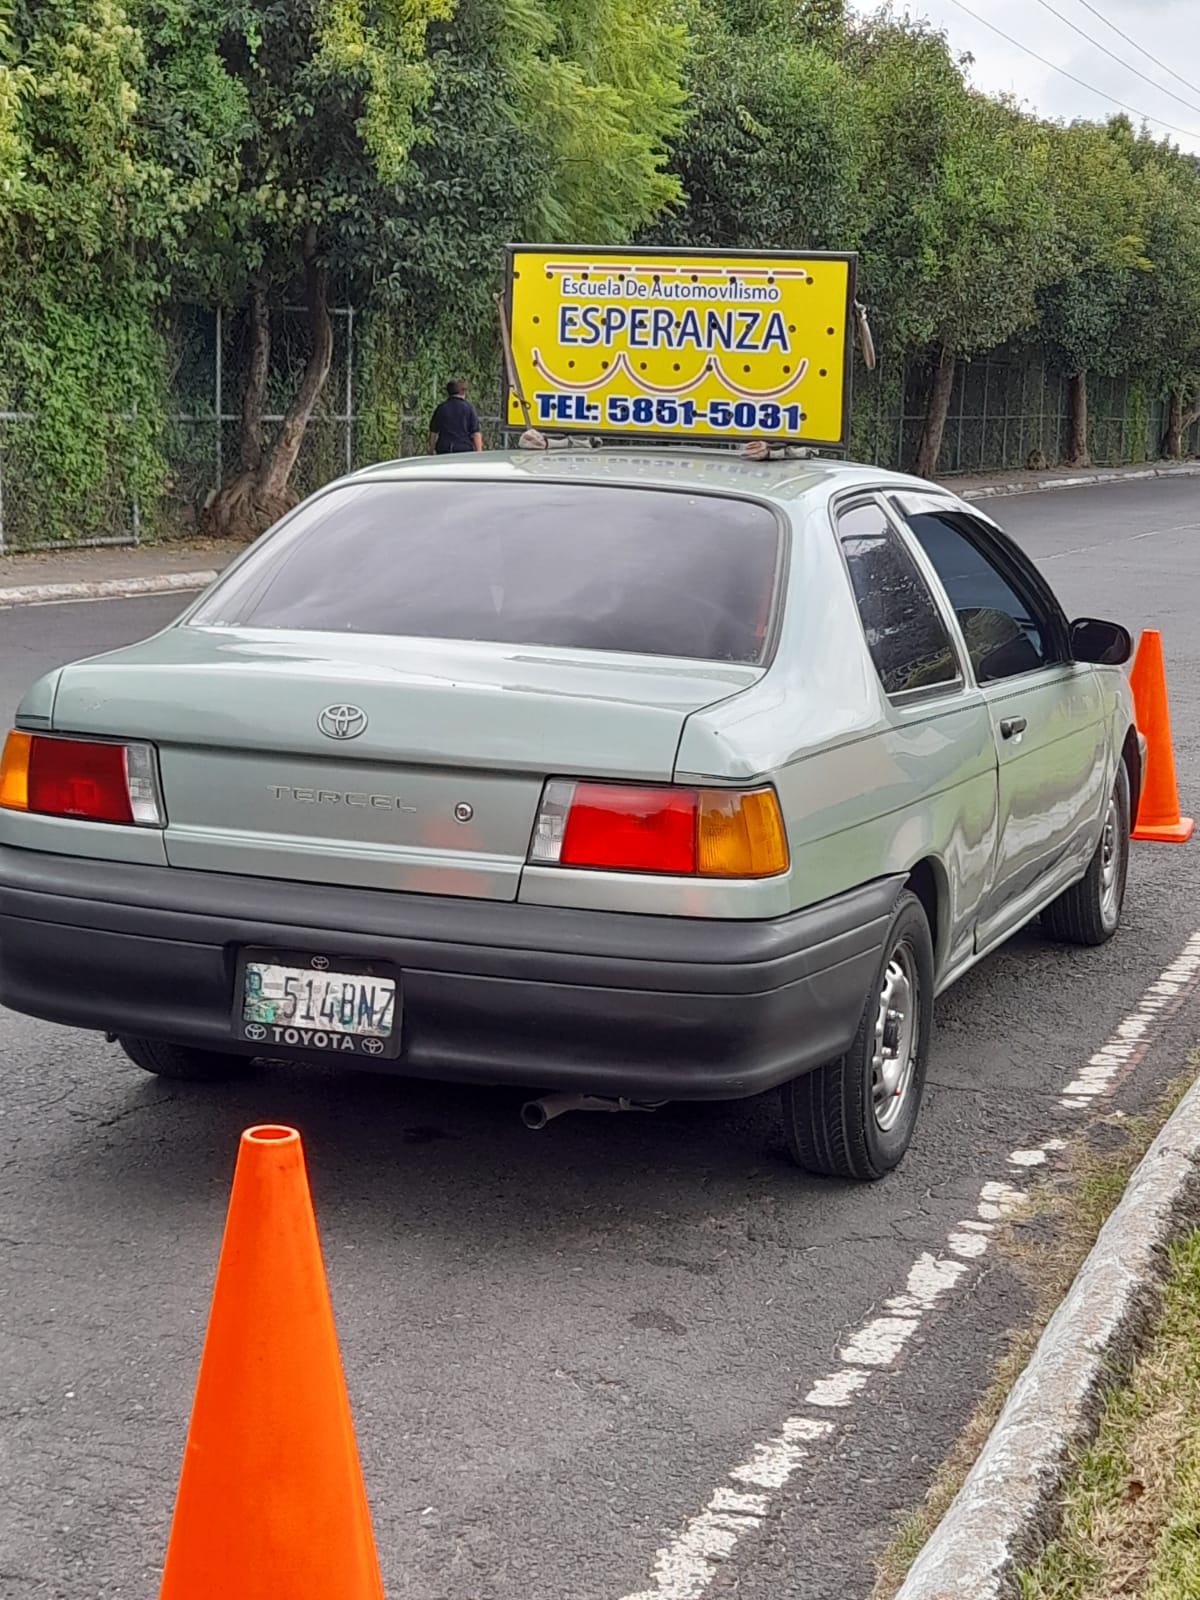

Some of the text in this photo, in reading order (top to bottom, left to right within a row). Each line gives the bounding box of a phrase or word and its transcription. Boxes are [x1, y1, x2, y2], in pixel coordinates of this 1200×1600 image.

[561, 277, 780, 301] Escuela De Automovilismo
[560, 306, 790, 351] ESPERANZA
[535, 393, 801, 431] TEL: 5851-5031
[268, 784, 417, 812] TERCEL
[272, 1027, 355, 1050] TOYOTA
